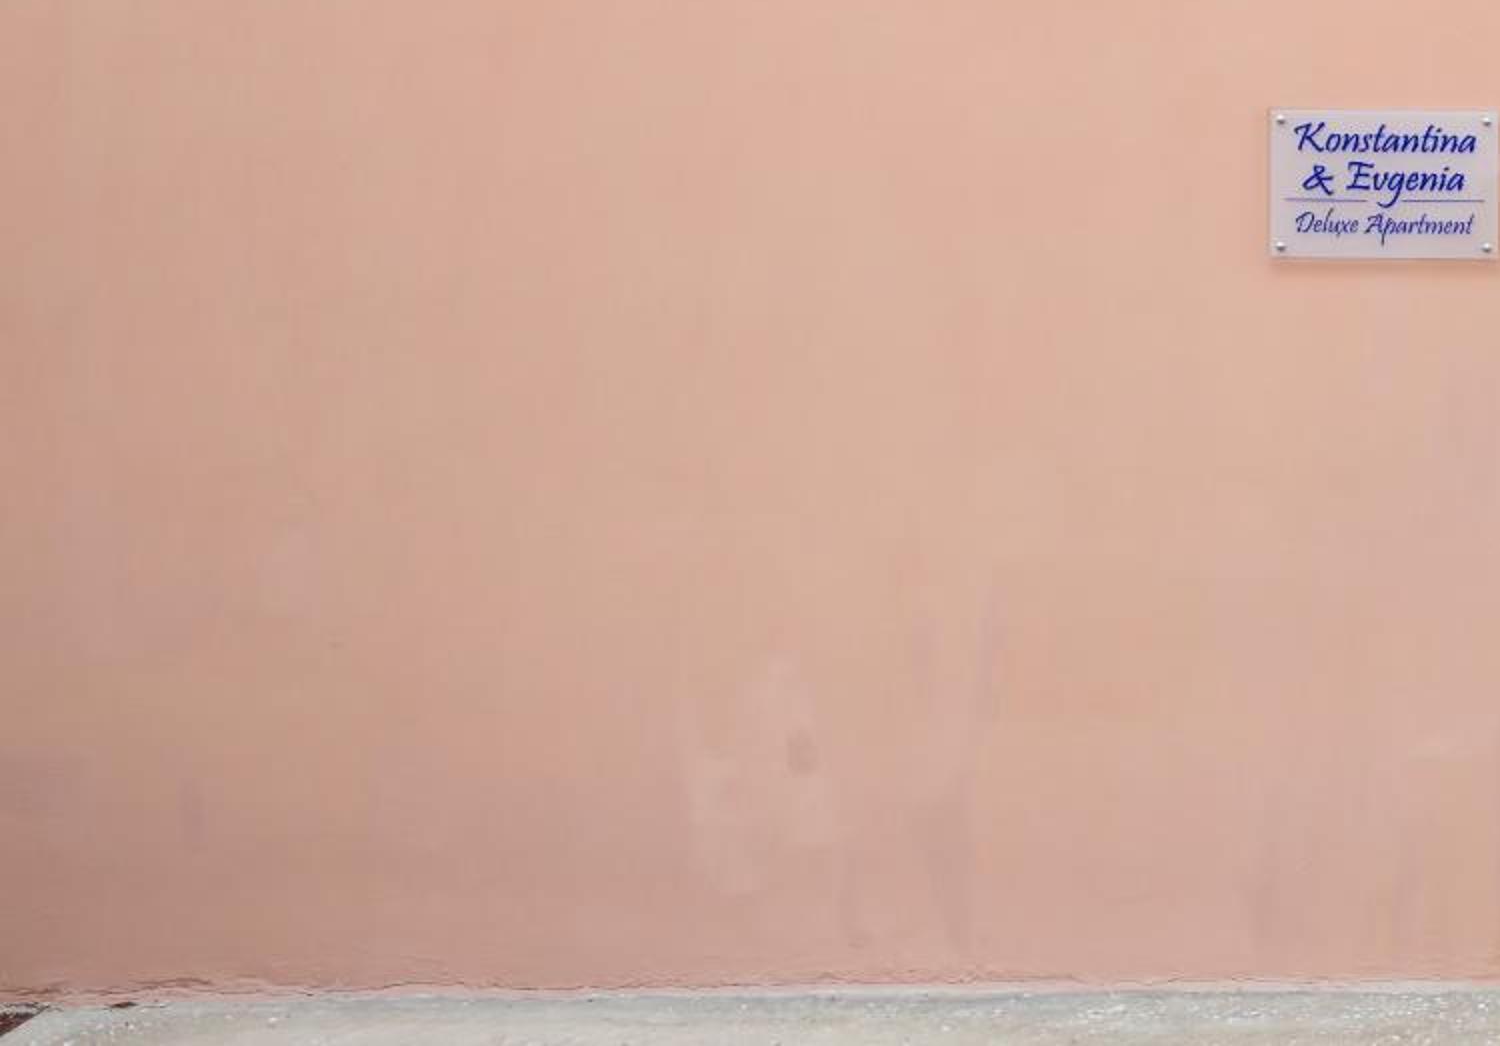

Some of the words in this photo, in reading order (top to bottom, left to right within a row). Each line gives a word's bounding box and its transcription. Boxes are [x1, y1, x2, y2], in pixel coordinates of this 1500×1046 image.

[1294, 121, 1477, 154] Konstantina
[1302, 164, 1335, 196] &
[1346, 161, 1465, 208] Evgenia
[1295, 208, 1359, 239] Deluxe
[1364, 213, 1475, 246] Apartment
